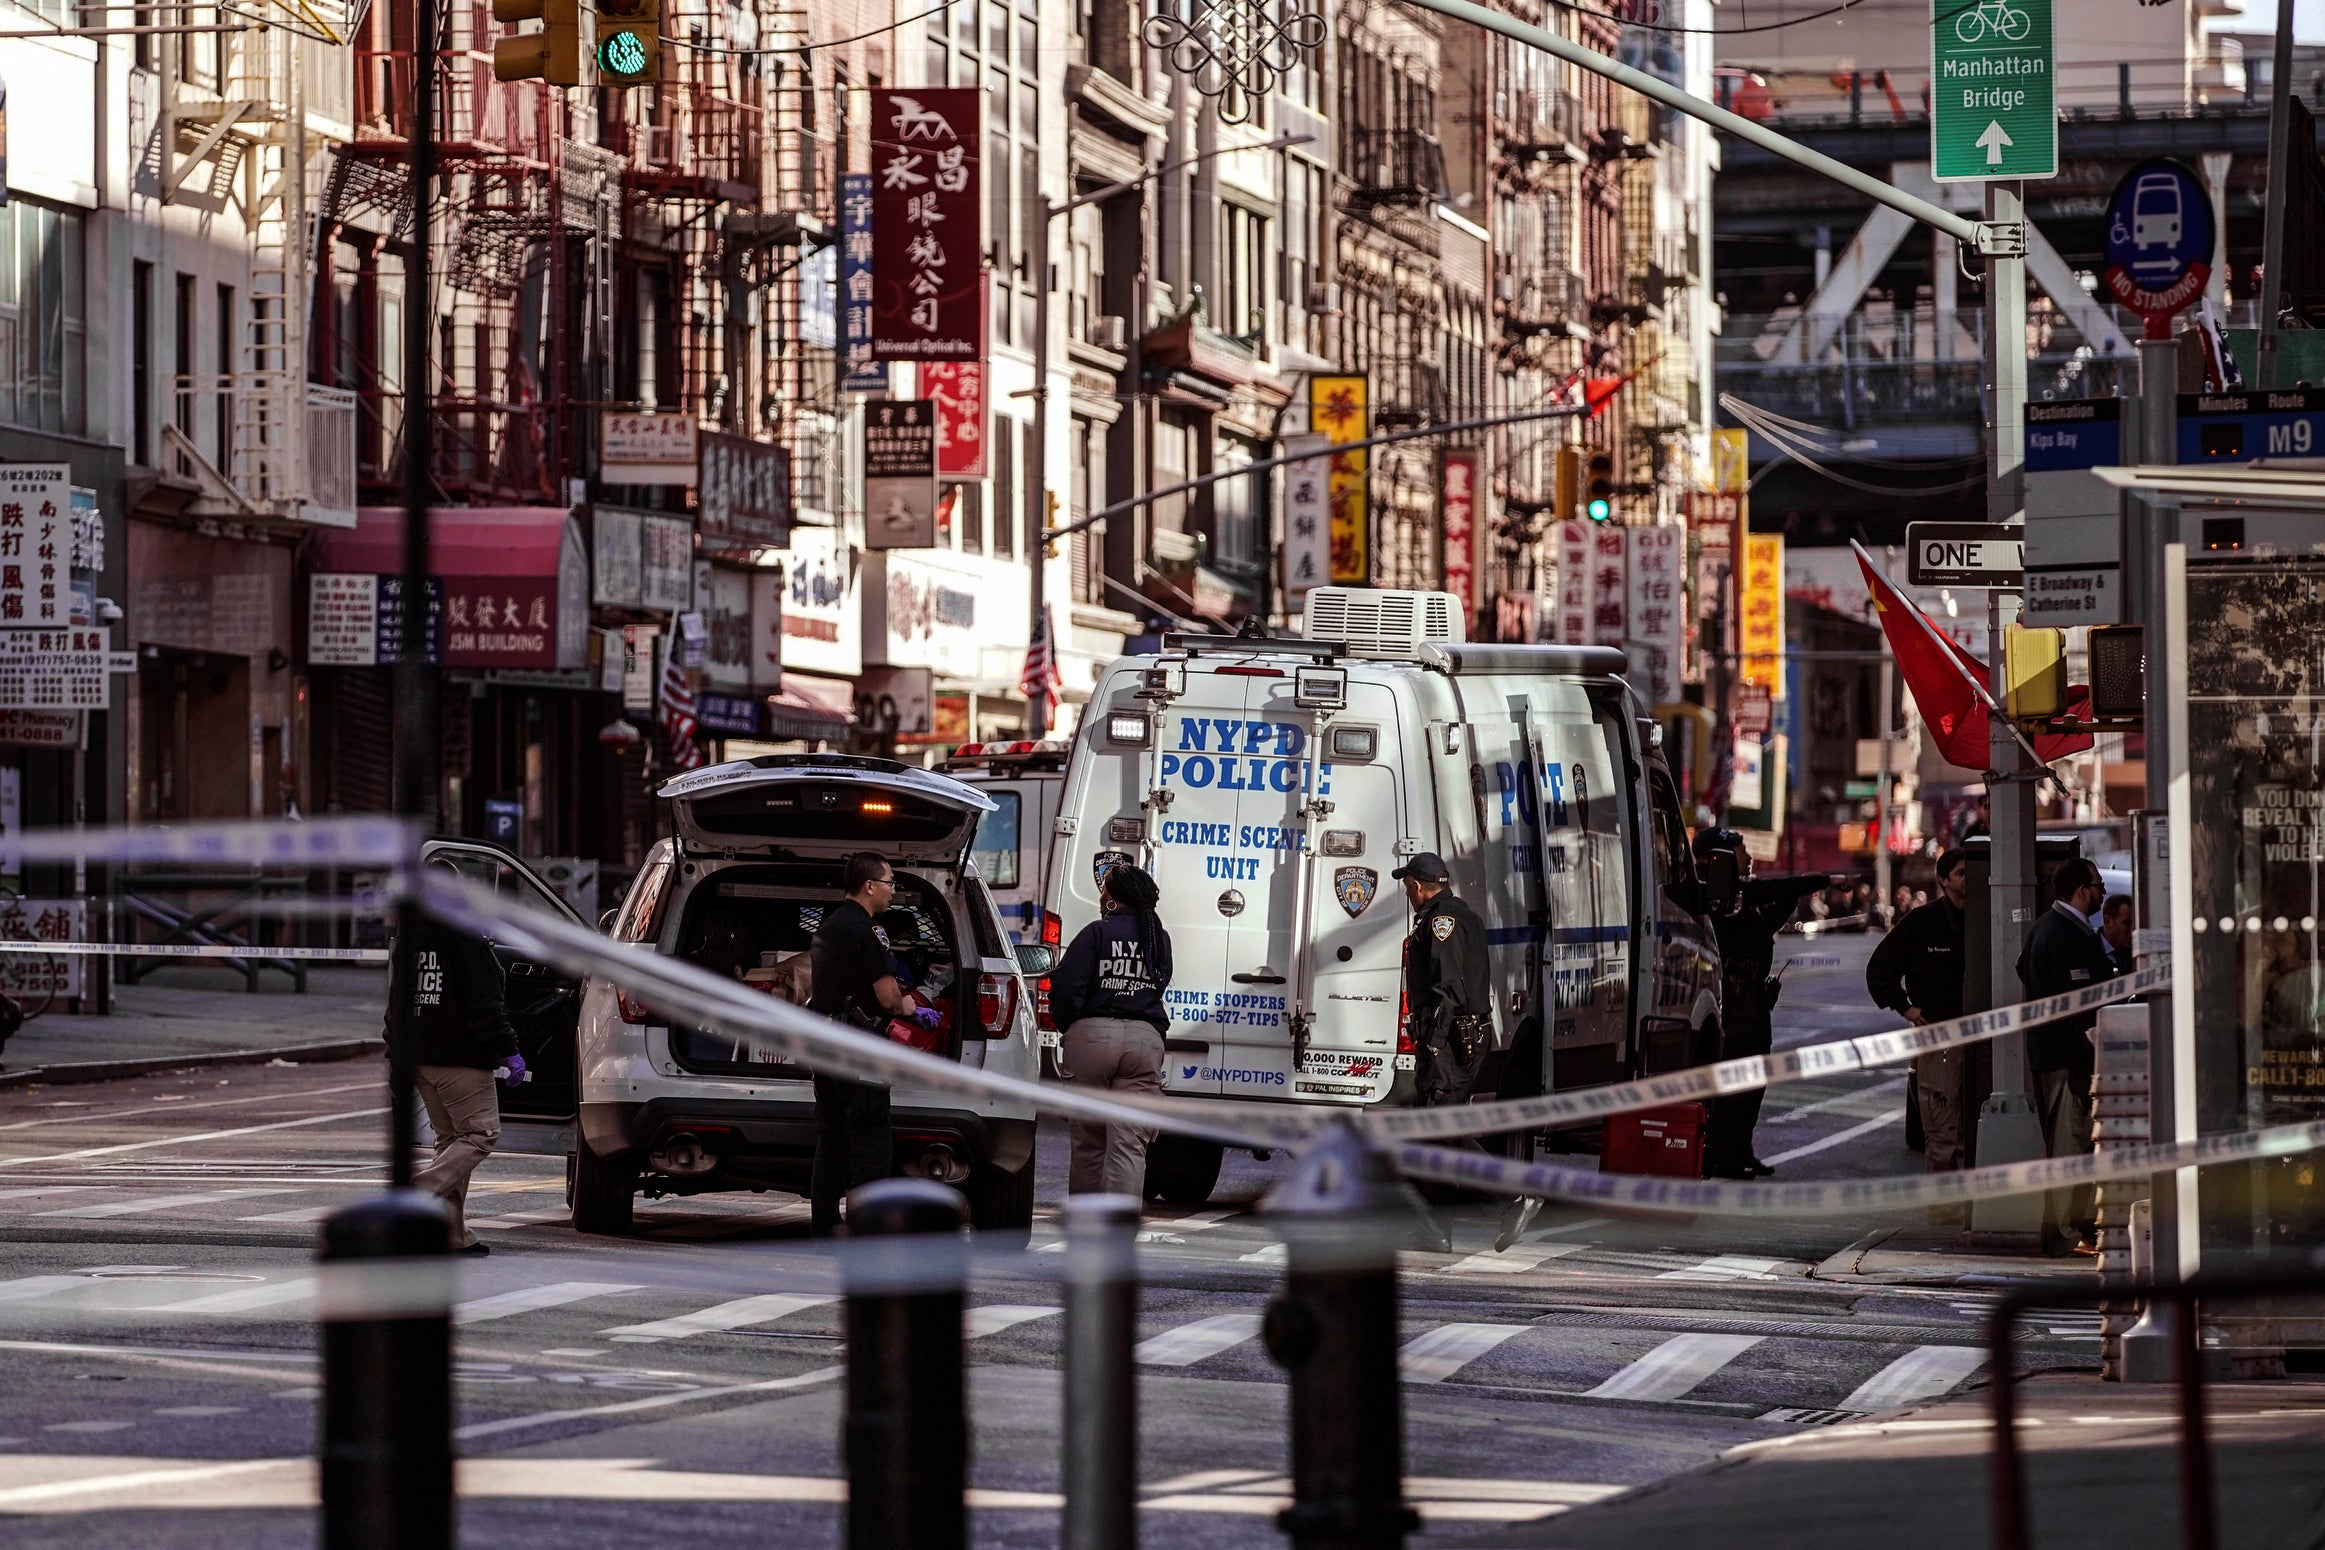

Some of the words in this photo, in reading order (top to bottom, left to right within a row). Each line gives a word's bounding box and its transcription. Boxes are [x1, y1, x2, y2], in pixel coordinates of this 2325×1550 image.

[1944, 56, 2044, 77] Manhattan
[1963, 87, 2025, 111] Bridge
[2112, 271, 2132, 296] NO
[2134, 272, 2199, 309] STANDING
[2198, 396, 2248, 411] Minutes
[2268, 393, 2305, 409] Route
[2029, 403, 2095, 421] Destination
[2029, 431, 2053, 448] Kips
[2057, 430, 2078, 448] Bay
[2268, 419, 2312, 453] M9
[1, 502, 24, 619] 跌打風傷
[1926, 543, 1983, 567] ONE
[2030, 577, 2037, 591] E
[2040, 575, 2093, 592] Broadway
[2096, 573, 2105, 588] &
[2029, 596, 2081, 612] Catherine
[2084, 595, 2097, 610] St
[478, 633, 545, 651] BUILDING
[22, 711, 74, 730] Pharmacy
[1179, 717, 1306, 756] NYPD
[1150, 754, 1332, 795] POLICE
[2257, 790, 2289, 807] YOU
[2243, 808, 2303, 825] REVEAL
[1162, 821, 1230, 847] CRIME
[1240, 825, 1307, 850] SCENE
[2277, 826, 2297, 843] TO
[1207, 856, 1259, 880] UNIT
[1337, 873, 1375, 883] DEPARTMENT
[1165, 990, 1208, 1006] CRIME
[1214, 992, 1285, 1011] STOPPERS
[1169, 1007, 1279, 1027] 1-800-577-TIPS
[1303, 1052, 1335, 1064] 0,000
[1338, 1055, 1383, 1067] REWARD
[1200, 1067, 1285, 1085] @NYPDTIPS
[1312, 1066, 1329, 1075] 1-800
[2247, 1067, 2288, 1085] CALL
[1315, 1085, 1326, 1093] PAL
[1328, 1086, 1361, 1094] INSPIRES
